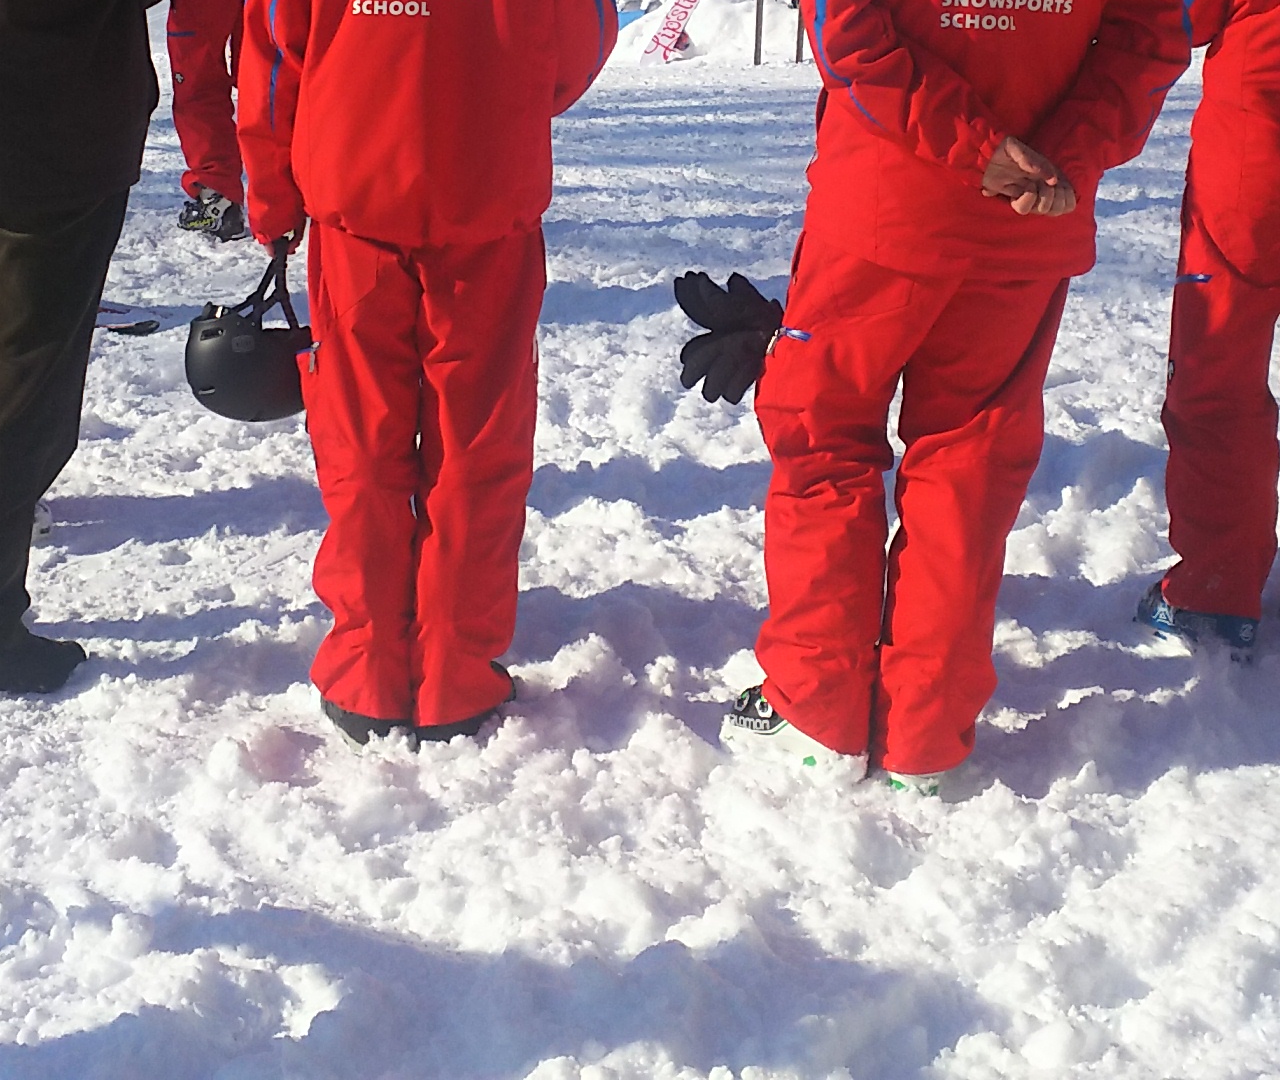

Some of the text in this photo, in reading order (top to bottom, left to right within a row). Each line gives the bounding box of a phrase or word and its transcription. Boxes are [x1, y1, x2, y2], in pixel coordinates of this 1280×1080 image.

[351, 0, 431, 17] SCHOOL
[940, 12, 1017, 31] SCHOOL
[724, 713, 771, 731] alomon
